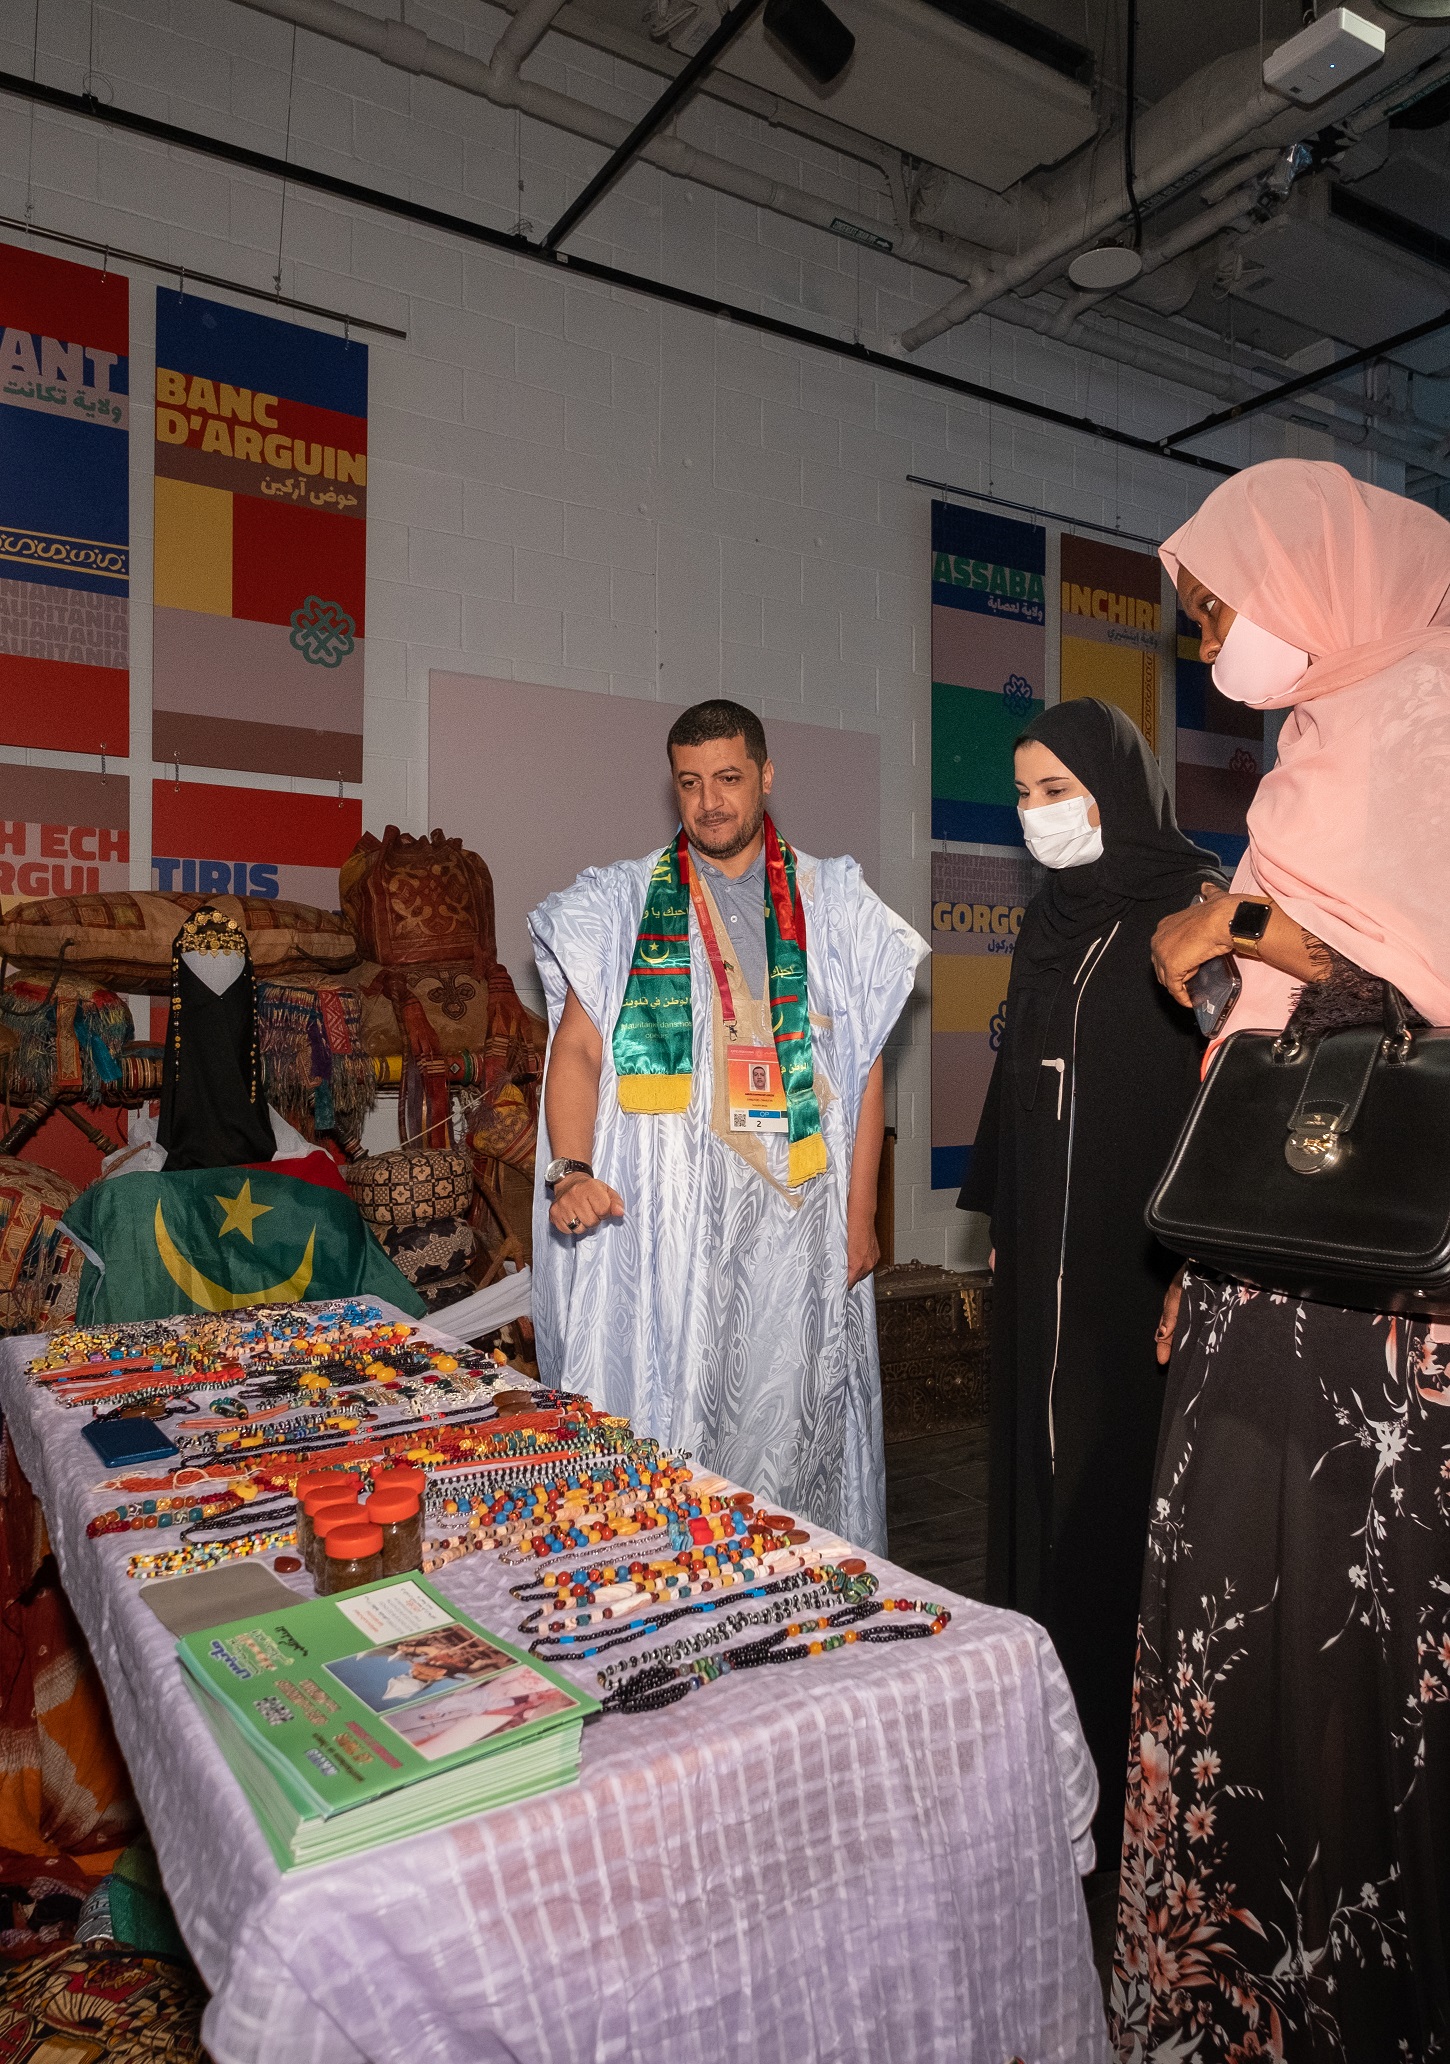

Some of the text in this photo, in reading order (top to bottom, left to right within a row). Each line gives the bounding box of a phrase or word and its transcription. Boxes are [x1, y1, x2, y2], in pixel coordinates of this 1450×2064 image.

[0, 327, 118, 392] ANT
[3, 381, 122, 423] ولاية تكانت
[157, 367, 279, 429] BANC
[157, 406, 366, 486] D'ARGUIN
[310, 488, 358, 509] حوض
[933, 551, 1044, 604] ASSABA
[1021, 602, 1043, 622] ولاية
[1062, 581, 1161, 633] INCHIRI
[0, 820, 129, 863] H ECH
[152, 857, 279, 900] TIRIS
[987, 939, 1016, 954] وركول
[650, 996, 661, 1009] في
[756, 1120, 762, 1128] 2
